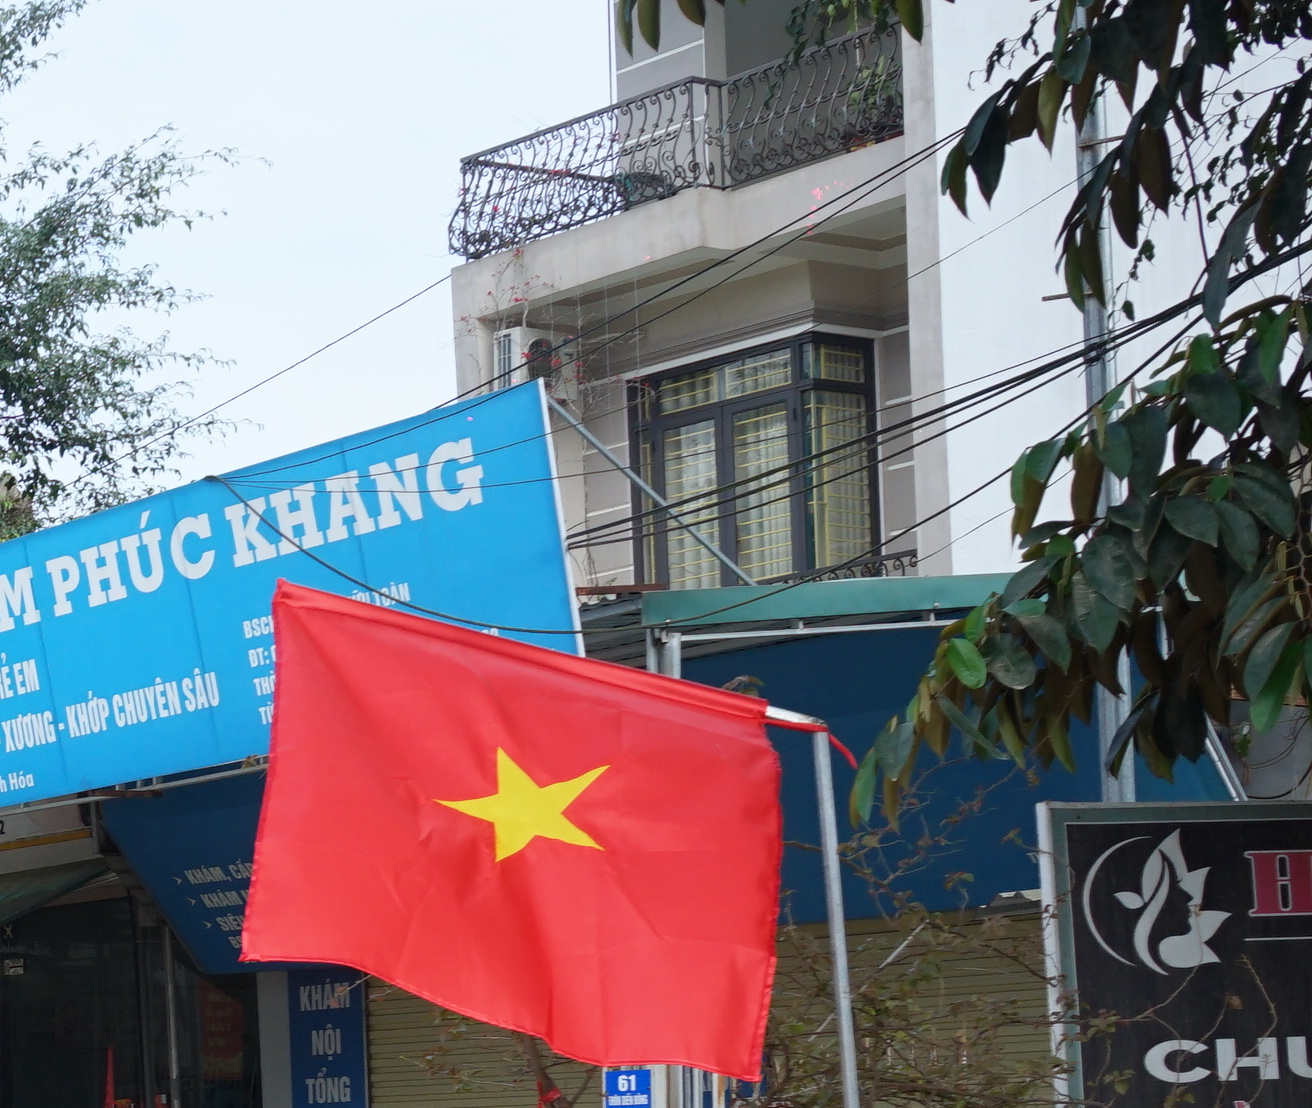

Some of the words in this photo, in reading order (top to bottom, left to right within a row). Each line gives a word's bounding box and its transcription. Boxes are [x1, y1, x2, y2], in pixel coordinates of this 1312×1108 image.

[45, 510, 216, 618] PHÚC
[224, 437, 485, 568] KHANG
[13, 658, 41, 696] EM
[1, 709, 56, 753] XƯƠNG
[65, 690, 110, 738] KHỚP
[112, 677, 182, 728] CHUYÊN
[182, 667, 220, 712] SÂU
[8, 770, 35, 792] Hóa
[184, 863, 231, 885] KHÁM,
[199, 888, 243, 909] KHÁM
[311, 1023, 342, 1061] NỘI
[306, 1068, 351, 1105] TỔNG
[617, 1074, 636, 1092] 61
